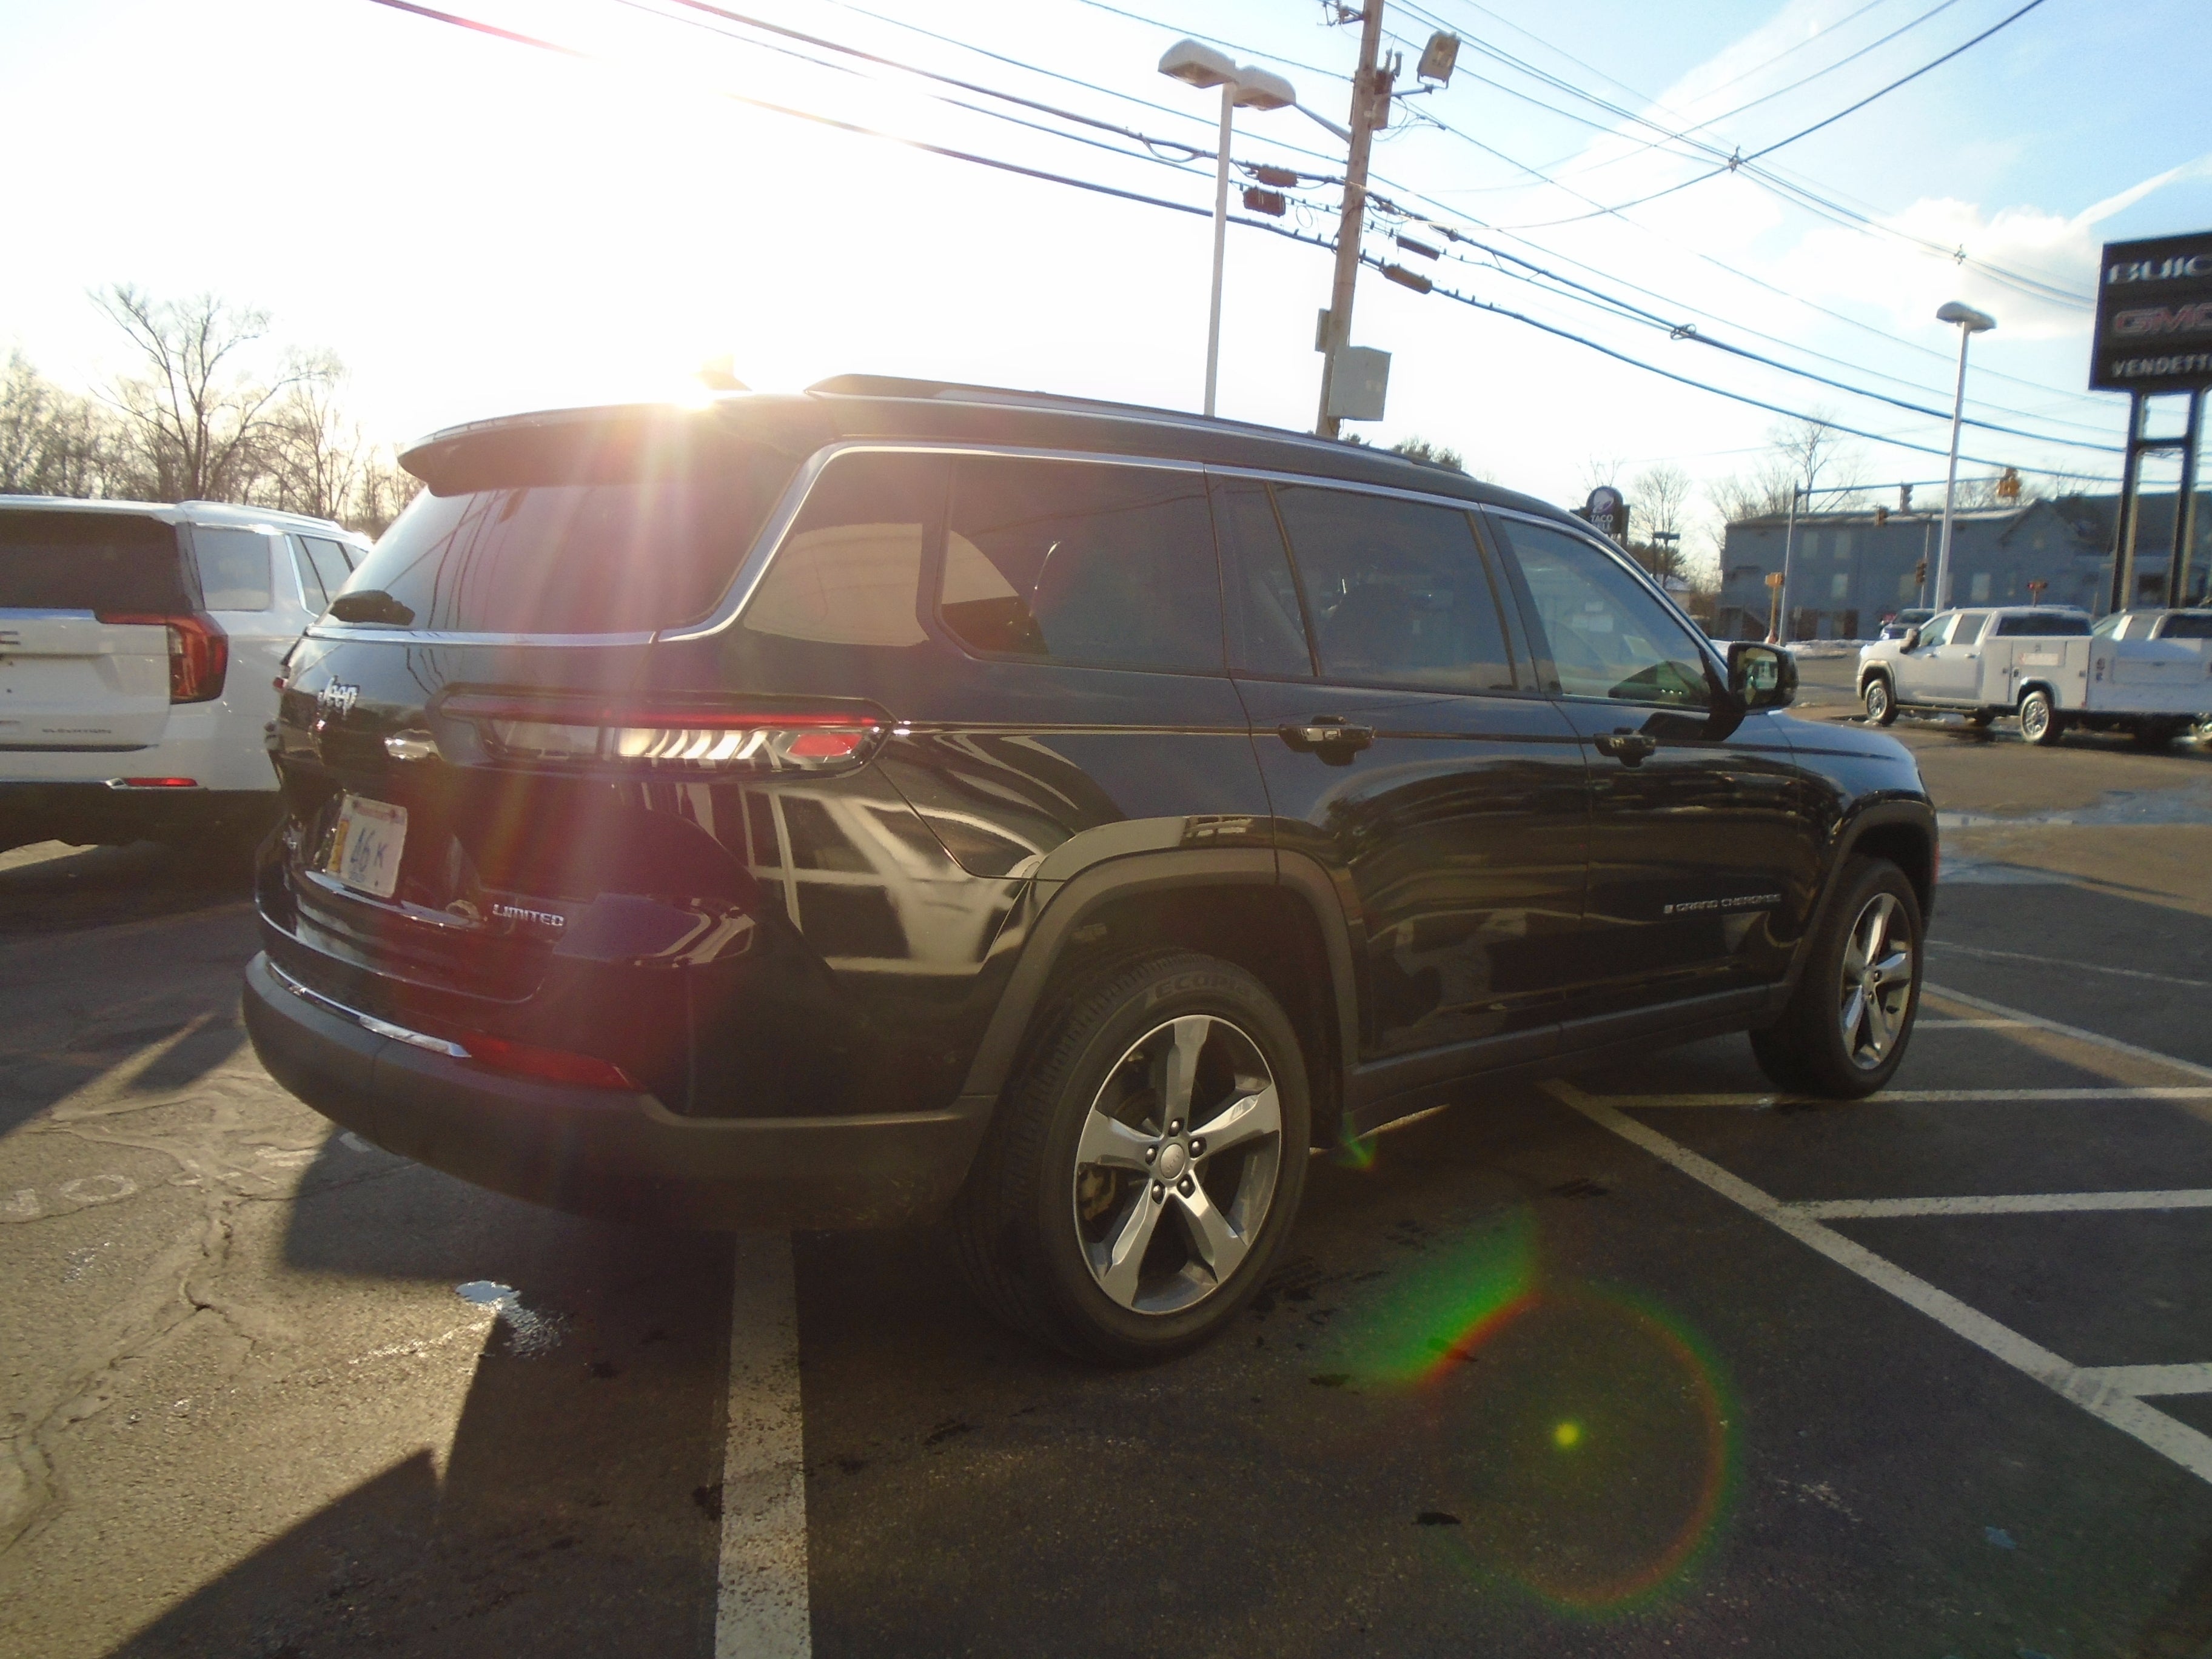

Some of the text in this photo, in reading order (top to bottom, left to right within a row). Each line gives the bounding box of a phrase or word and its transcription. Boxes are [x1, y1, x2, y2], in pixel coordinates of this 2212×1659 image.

[2111, 353, 2212, 378] VENDETT
[1590, 514, 1614, 523] TACO
[317, 676, 358, 716] Jeep
[492, 904, 564, 927] LIMITED
